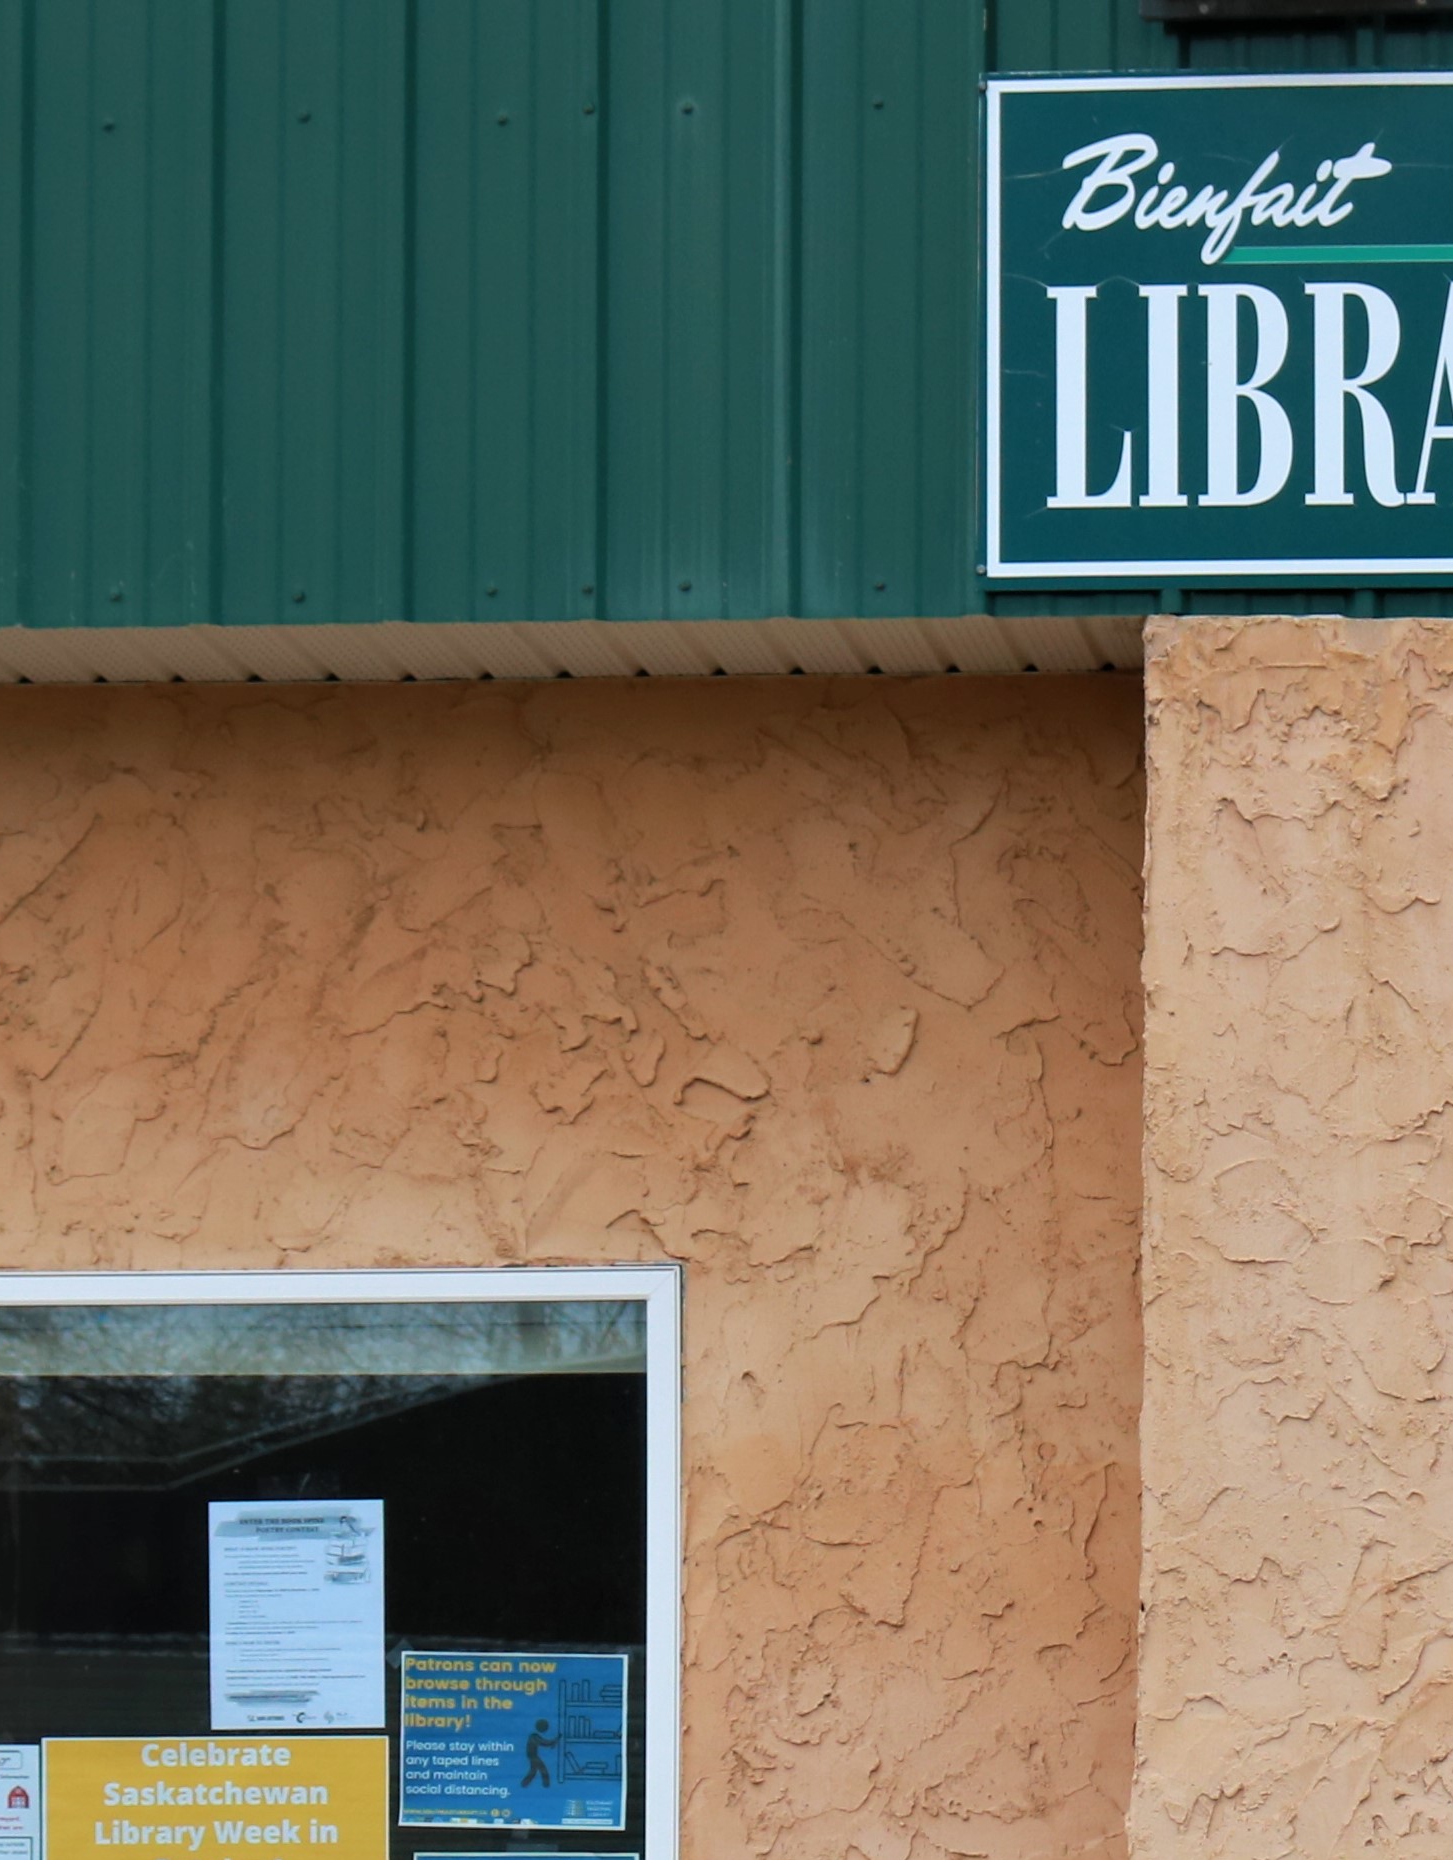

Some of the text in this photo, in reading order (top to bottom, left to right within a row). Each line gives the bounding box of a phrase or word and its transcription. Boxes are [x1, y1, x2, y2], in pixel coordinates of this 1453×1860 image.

[1061, 132, 1392, 264] Bienfait
[406, 1658, 556, 1673] Patrons can now
[406, 1677, 547, 1695] browse through
[406, 1696, 513, 1709] items in the
[404, 1714, 471, 1731] library!
[141, 1742, 291, 1767] Celebrate
[406, 1741, 514, 1753] Please stay within
[406, 1755, 499, 1768] any taped lines
[406, 1770, 487, 1780] and maintain
[103, 1781, 328, 1806] Saskatchewan
[406, 1785, 511, 1798] social distancing.
[95, 1820, 338, 1851] Library Week in
